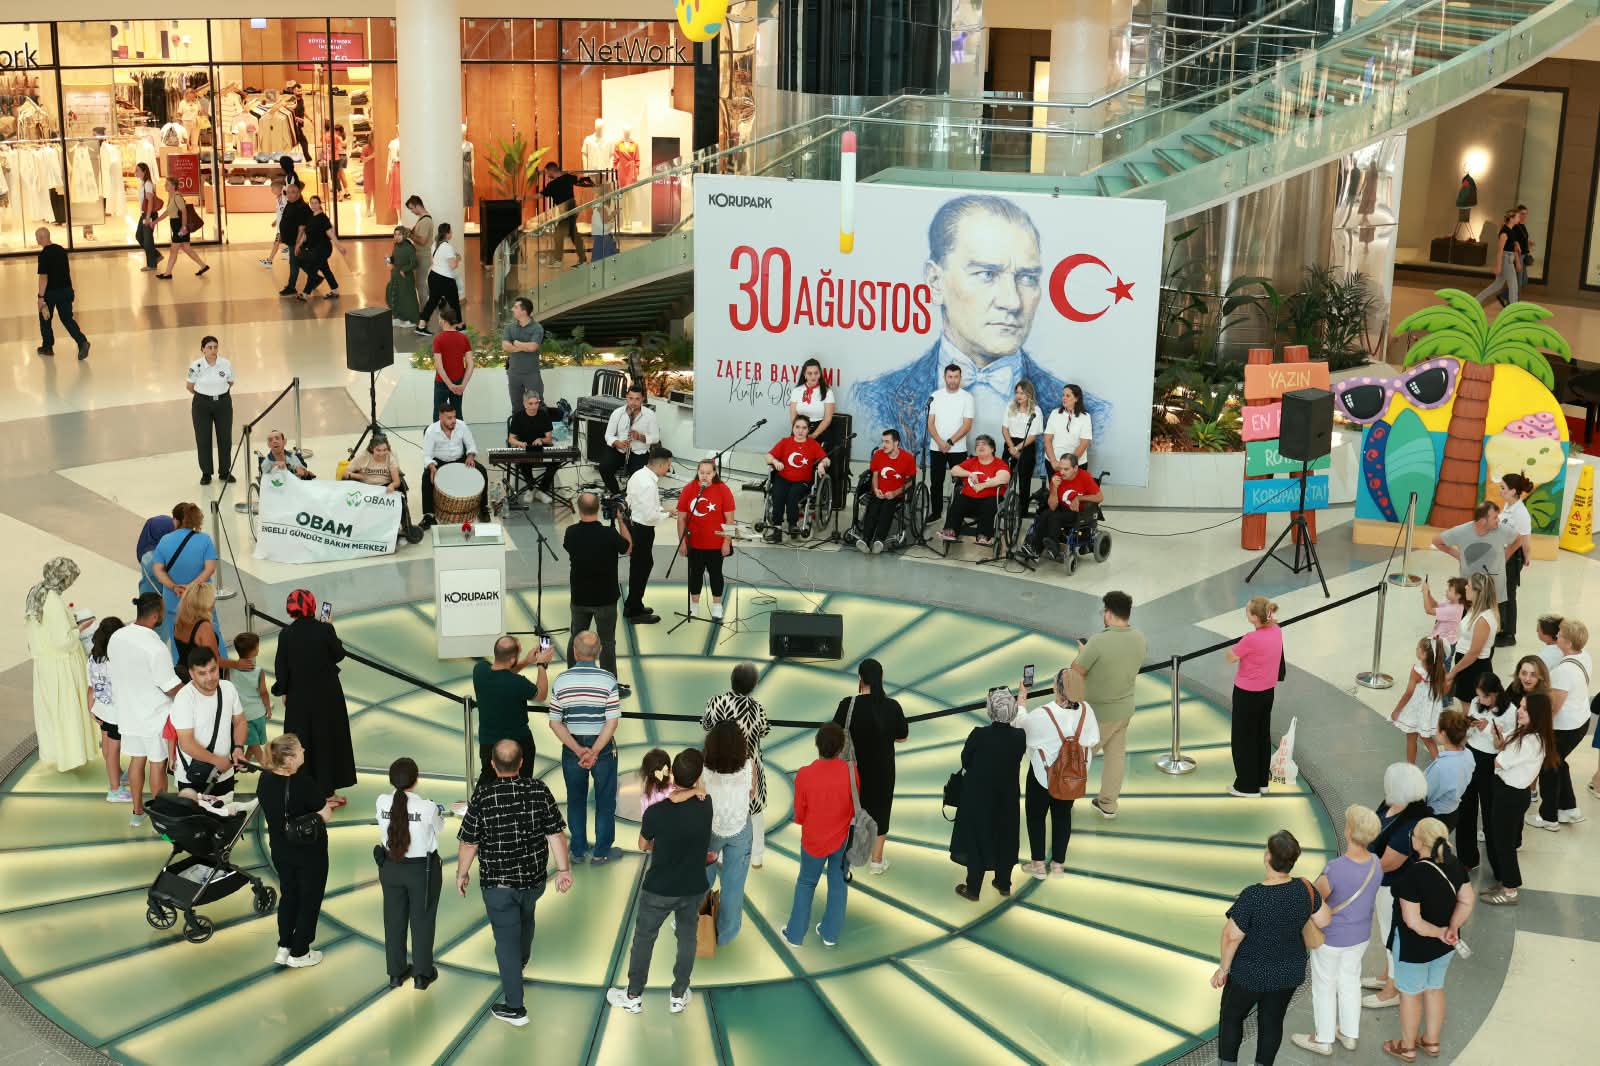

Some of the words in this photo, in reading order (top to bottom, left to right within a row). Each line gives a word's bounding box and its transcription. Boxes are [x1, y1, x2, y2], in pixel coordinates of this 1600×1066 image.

[578, 37, 687, 62] NetWork
[708, 193, 773, 208] KORUPARK
[729, 245, 791, 333] 30
[794, 268, 931, 334] AĞUSTOS
[716, 359, 762, 381] ZAFER
[770, 363, 840, 387] BAYMI
[1268, 369, 1311, 389] YAZIN
[767, 381, 792, 408] Ols
[1251, 411, 1271, 431] EN
[363, 495, 395, 508] OBAM
[295, 511, 353, 537] OBAM
[289, 529, 323, 543] GÜNDÜZ
[324, 538, 350, 549] BAKIM
[351, 543, 388, 553] MERKEZİ
[444, 591, 500, 604] KORUPARK
